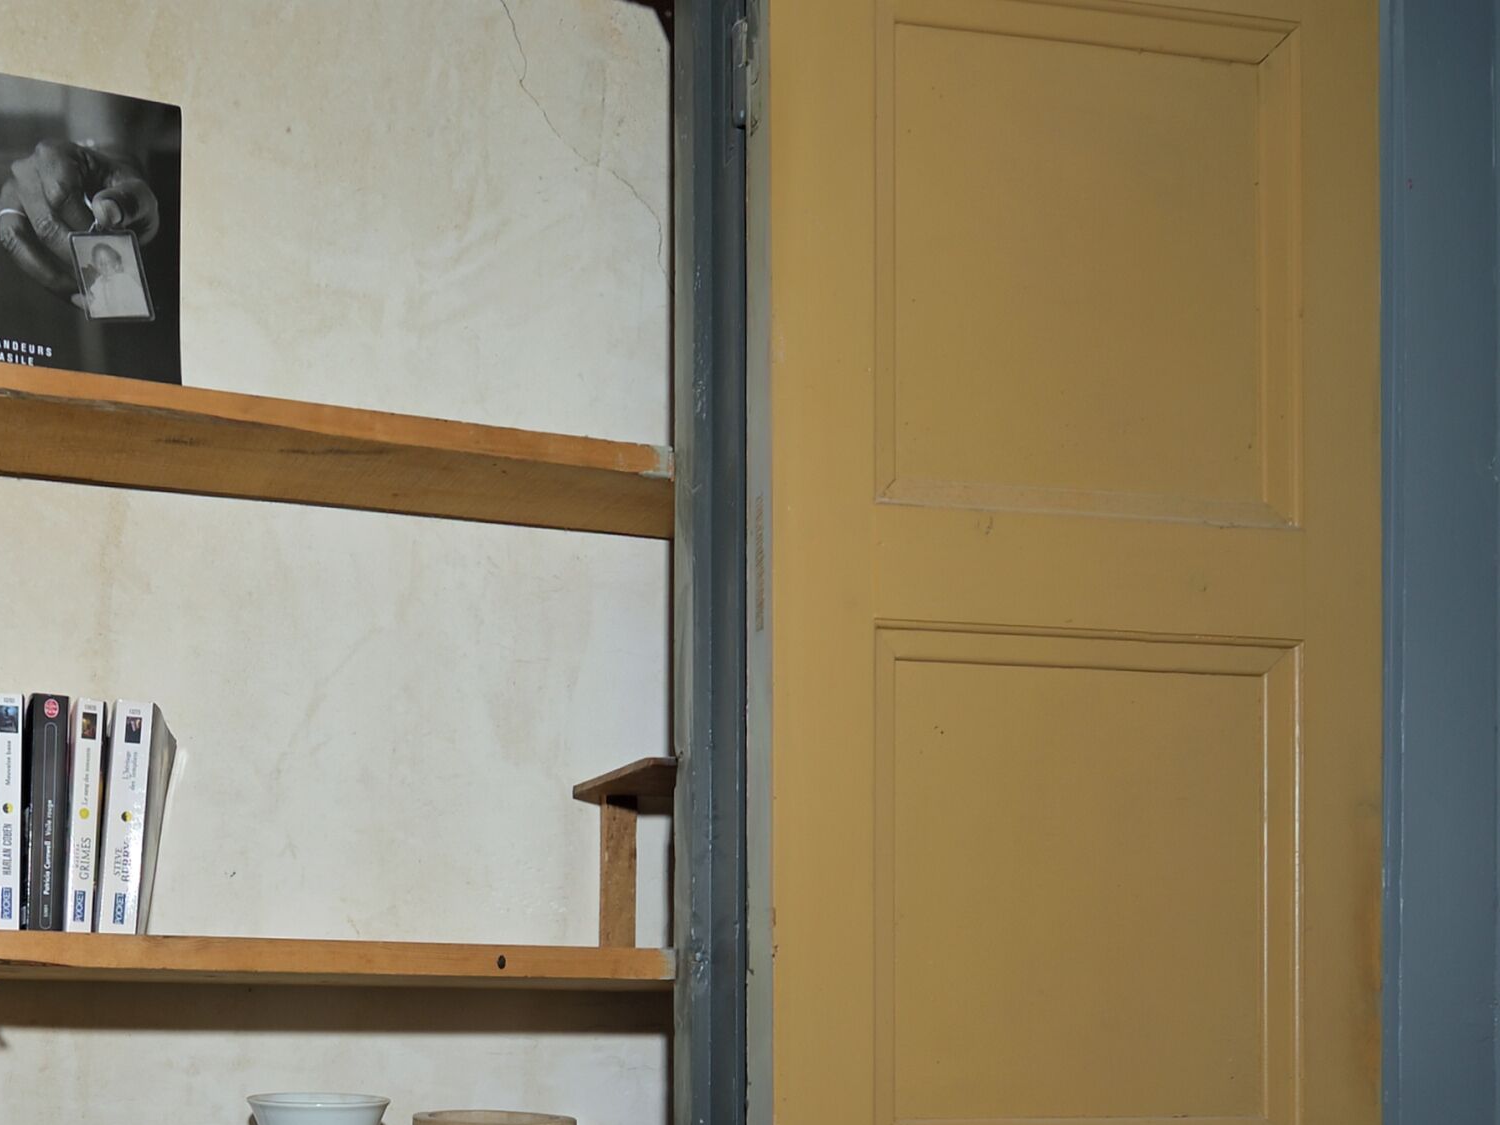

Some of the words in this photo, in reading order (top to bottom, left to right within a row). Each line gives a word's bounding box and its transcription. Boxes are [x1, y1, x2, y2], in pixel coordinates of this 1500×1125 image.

[46, 799, 54, 817] rouge
[3, 823, 12, 847] COBEN
[2, 848, 12, 875] HARLAN
[43, 841, 51, 869] Cornwell
[79, 837, 91, 880] GRIMES
[112, 848, 121, 876] STEVE
[43, 871, 51, 895] Patricia
[1, 887, 12, 920] POCKET
[74, 890, 85, 922] POCKET
[114, 892, 126, 924] POCKET
